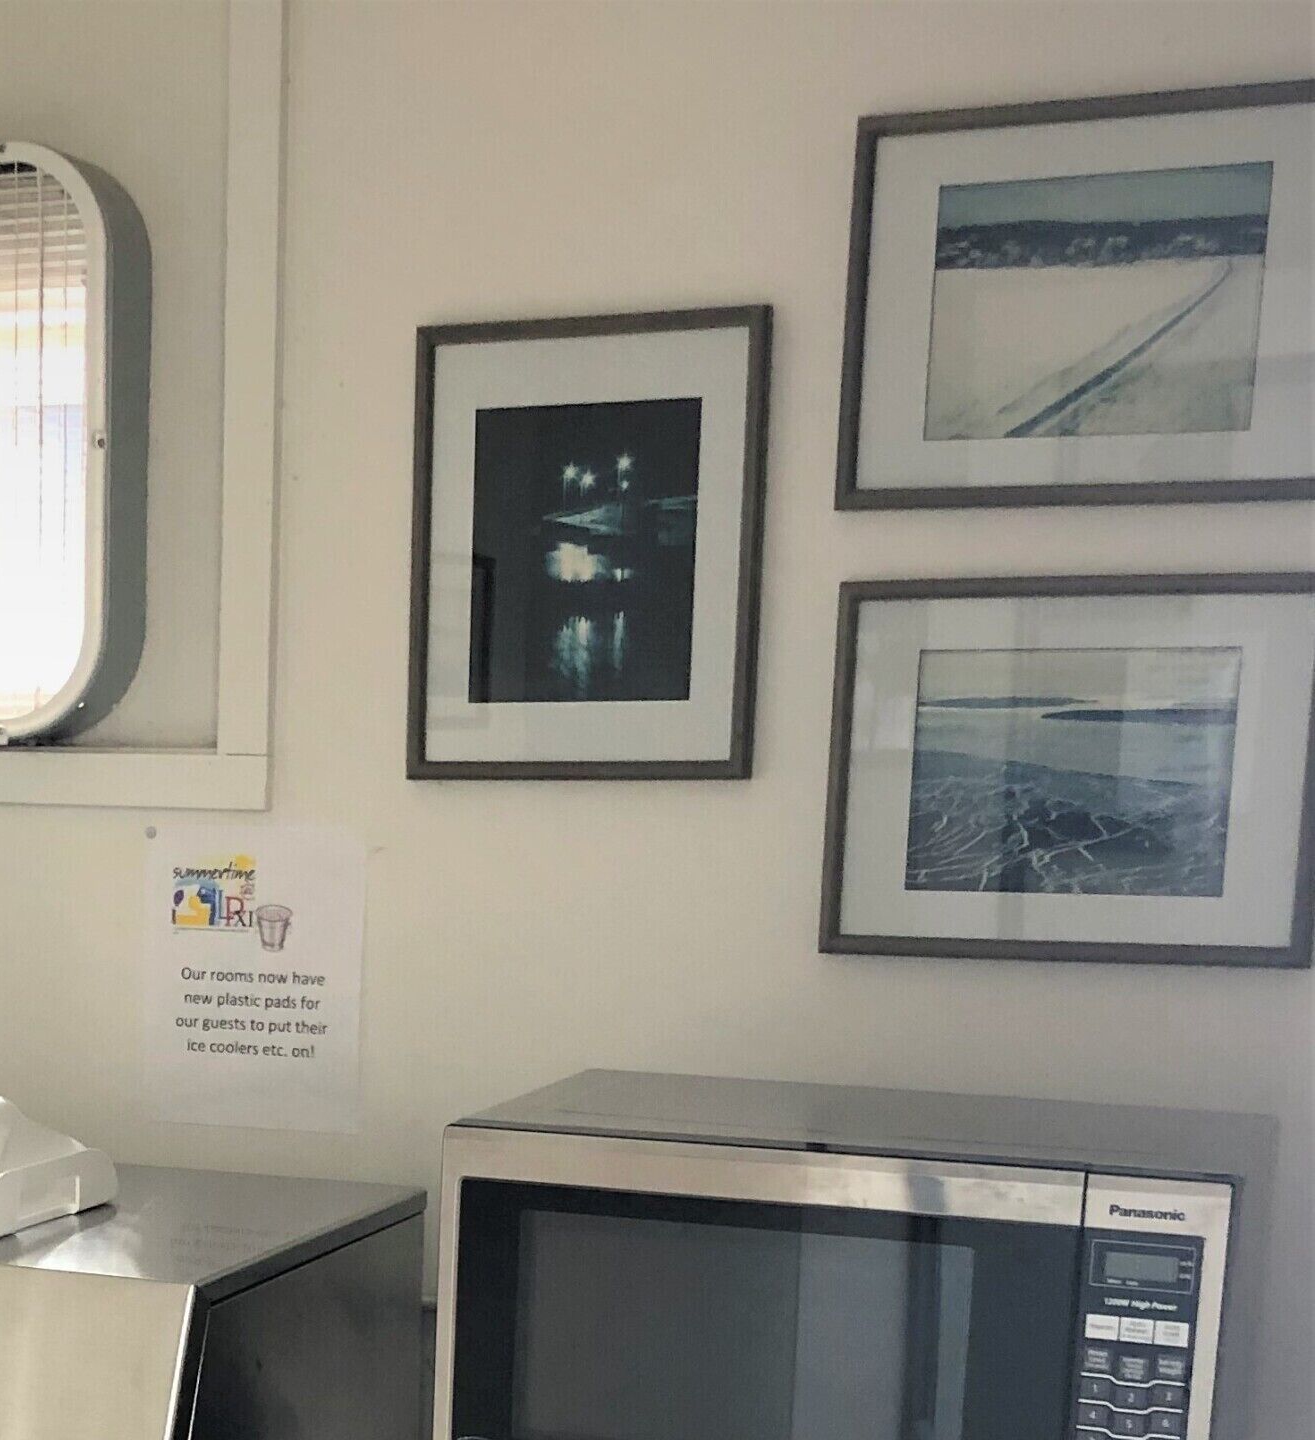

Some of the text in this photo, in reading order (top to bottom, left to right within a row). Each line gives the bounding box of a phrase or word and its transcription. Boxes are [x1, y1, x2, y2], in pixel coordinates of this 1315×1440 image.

[172, 861, 256, 880] summertime
[181, 967, 326, 986] Our rooms now have
[184, 993, 321, 1010] new plastic pads for
[175, 1017, 328, 1035] our guests to put their
[186, 1038, 315, 1058] ice coolers etc. on!
[1109, 1204, 1186, 1221] Panasonic
